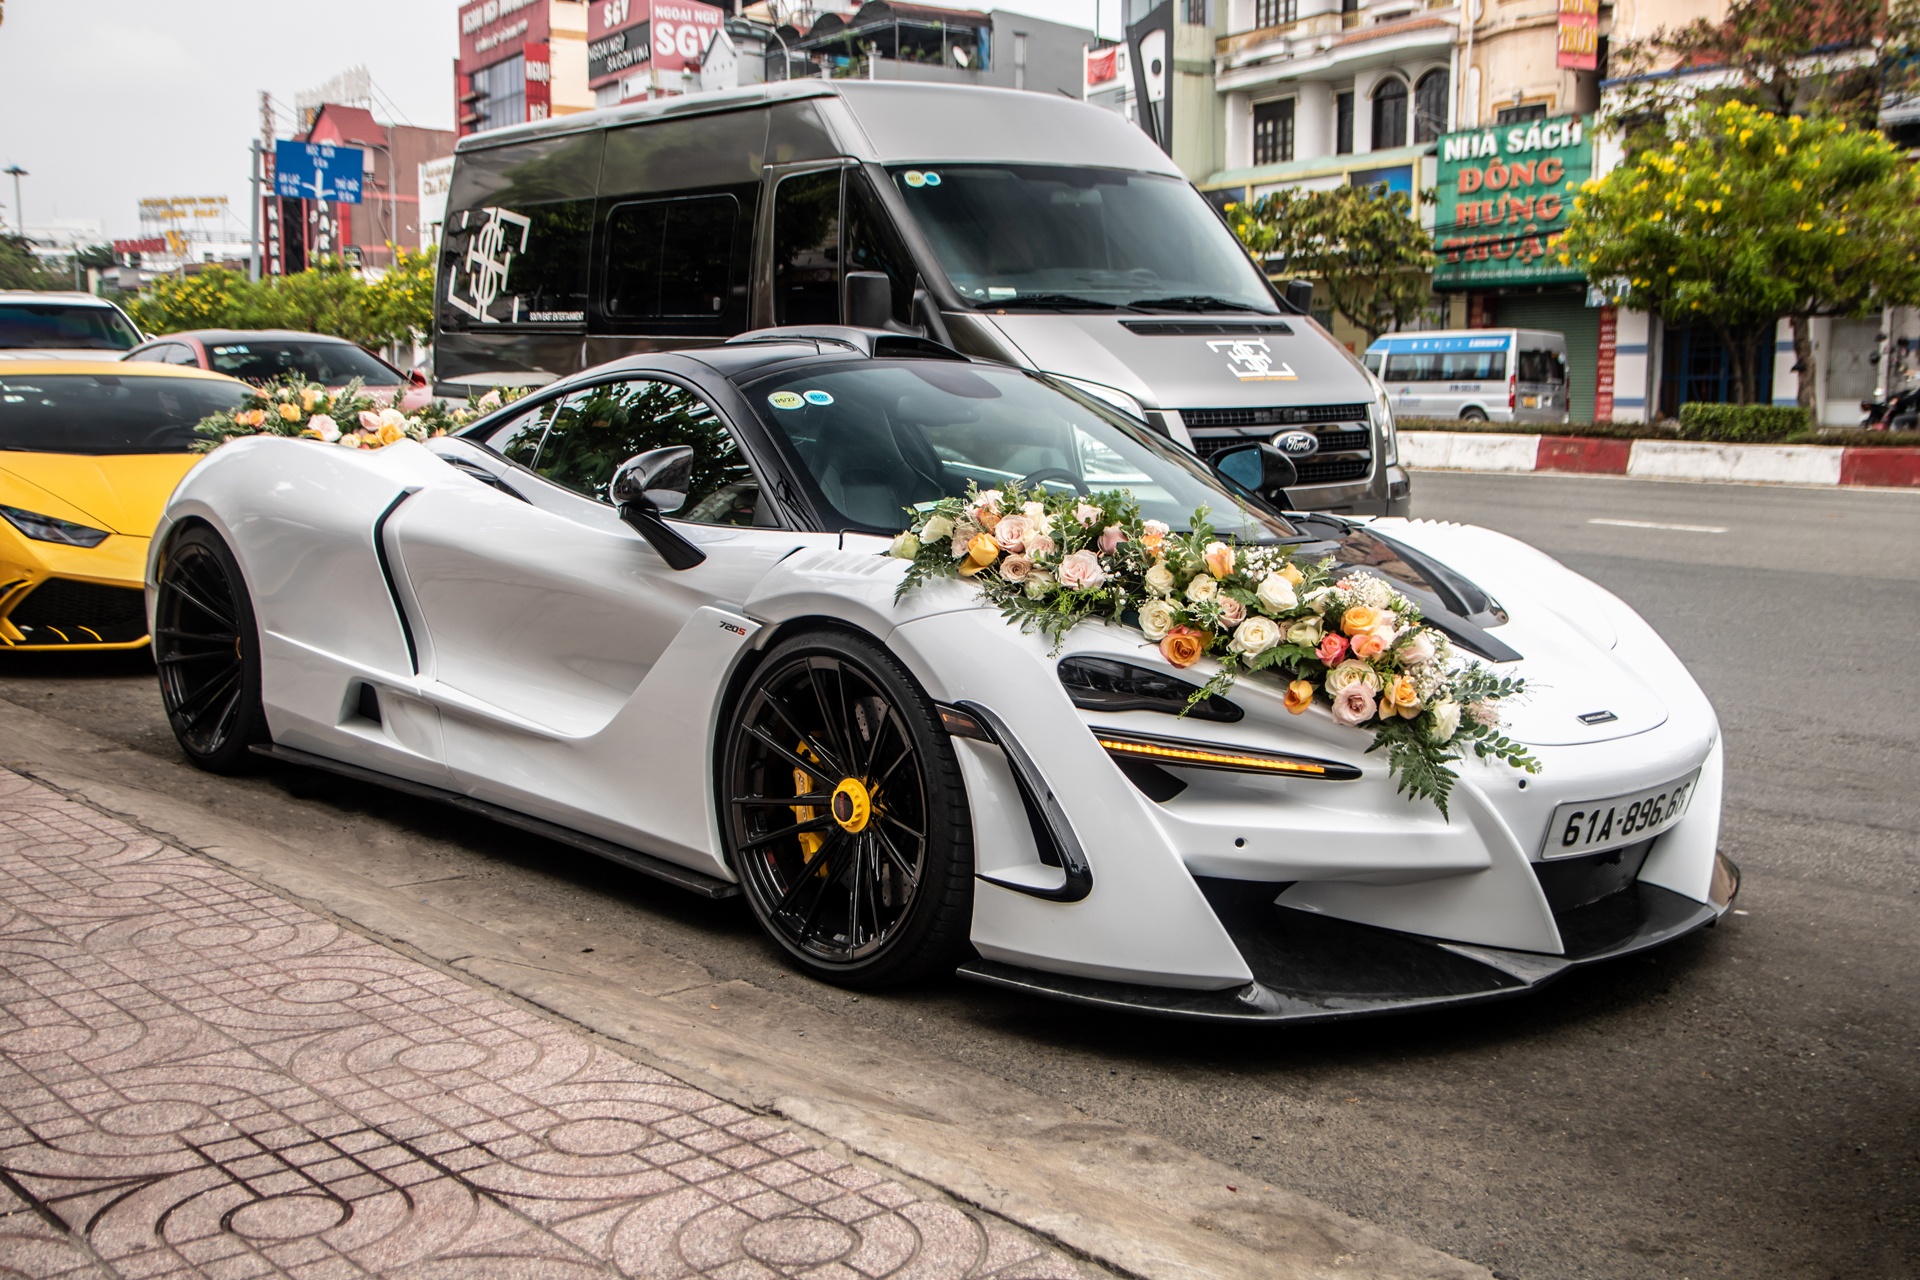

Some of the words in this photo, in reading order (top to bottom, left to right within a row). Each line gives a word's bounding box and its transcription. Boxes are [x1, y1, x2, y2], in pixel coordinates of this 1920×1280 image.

[655, 5, 692, 24] NGOẠI
[655, 21, 717, 58] SGV
[1443, 126, 1498, 163] NHÀ
[1506, 119, 1583, 154] SÁCH
[1455, 191, 1564, 228] HƯNG
[1286, 435, 1311, 451] Ford
[719, 620, 747, 636] 720S
